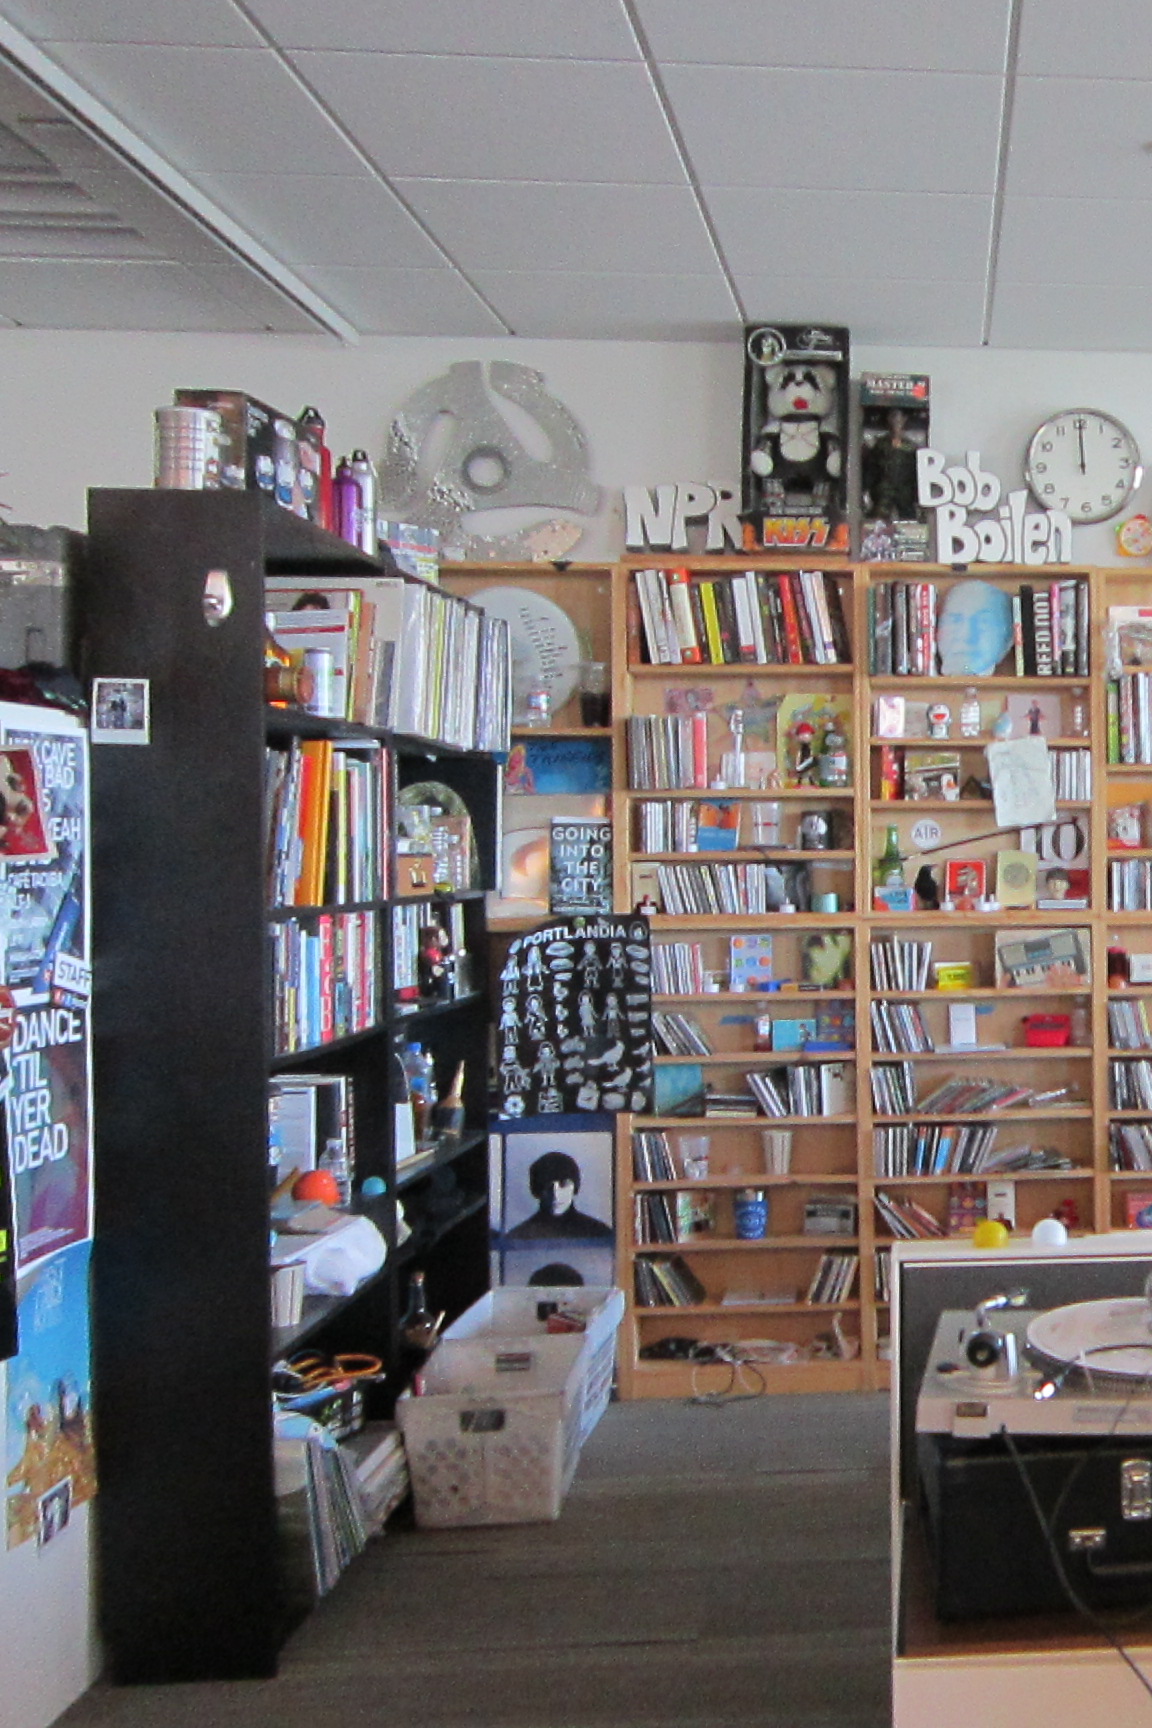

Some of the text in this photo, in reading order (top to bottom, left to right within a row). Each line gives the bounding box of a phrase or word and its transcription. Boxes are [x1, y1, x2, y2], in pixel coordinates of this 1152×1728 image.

[1056, 426, 1066, 436] 11
[1099, 424, 1104, 434] 1
[1041, 441, 1053, 452] 10
[1112, 437, 1122, 448] 2
[1036, 462, 1047, 473] 9
[1119, 458, 1130, 470] 3
[917, 448, 1001, 511] Bob
[1115, 478, 1125, 490] 4
[1044, 483, 1056, 494] 8
[1061, 497, 1070, 508] 7
[1080, 501, 1092, 513] 6
[1102, 494, 1112, 506] 5
[623, 481, 746, 554] NPR
[763, 516, 830, 547] KISS
[936, 489, 1072, 565] Boilen
[42, 740, 76, 766] CAVE
[45, 765, 75, 788] BAD
[552, 826, 611, 842] GOING
[914, 826, 940, 840] AIR
[560, 844, 604, 858] INTO
[564, 861, 600, 875] THE
[561, 877, 601, 892] CITY
[522, 924, 627, 949] PORTLANDIA
[12, 1009, 83, 1053] DANCE
[12, 1089, 51, 1132] YER
[14, 1123, 69, 1174] DEAD
